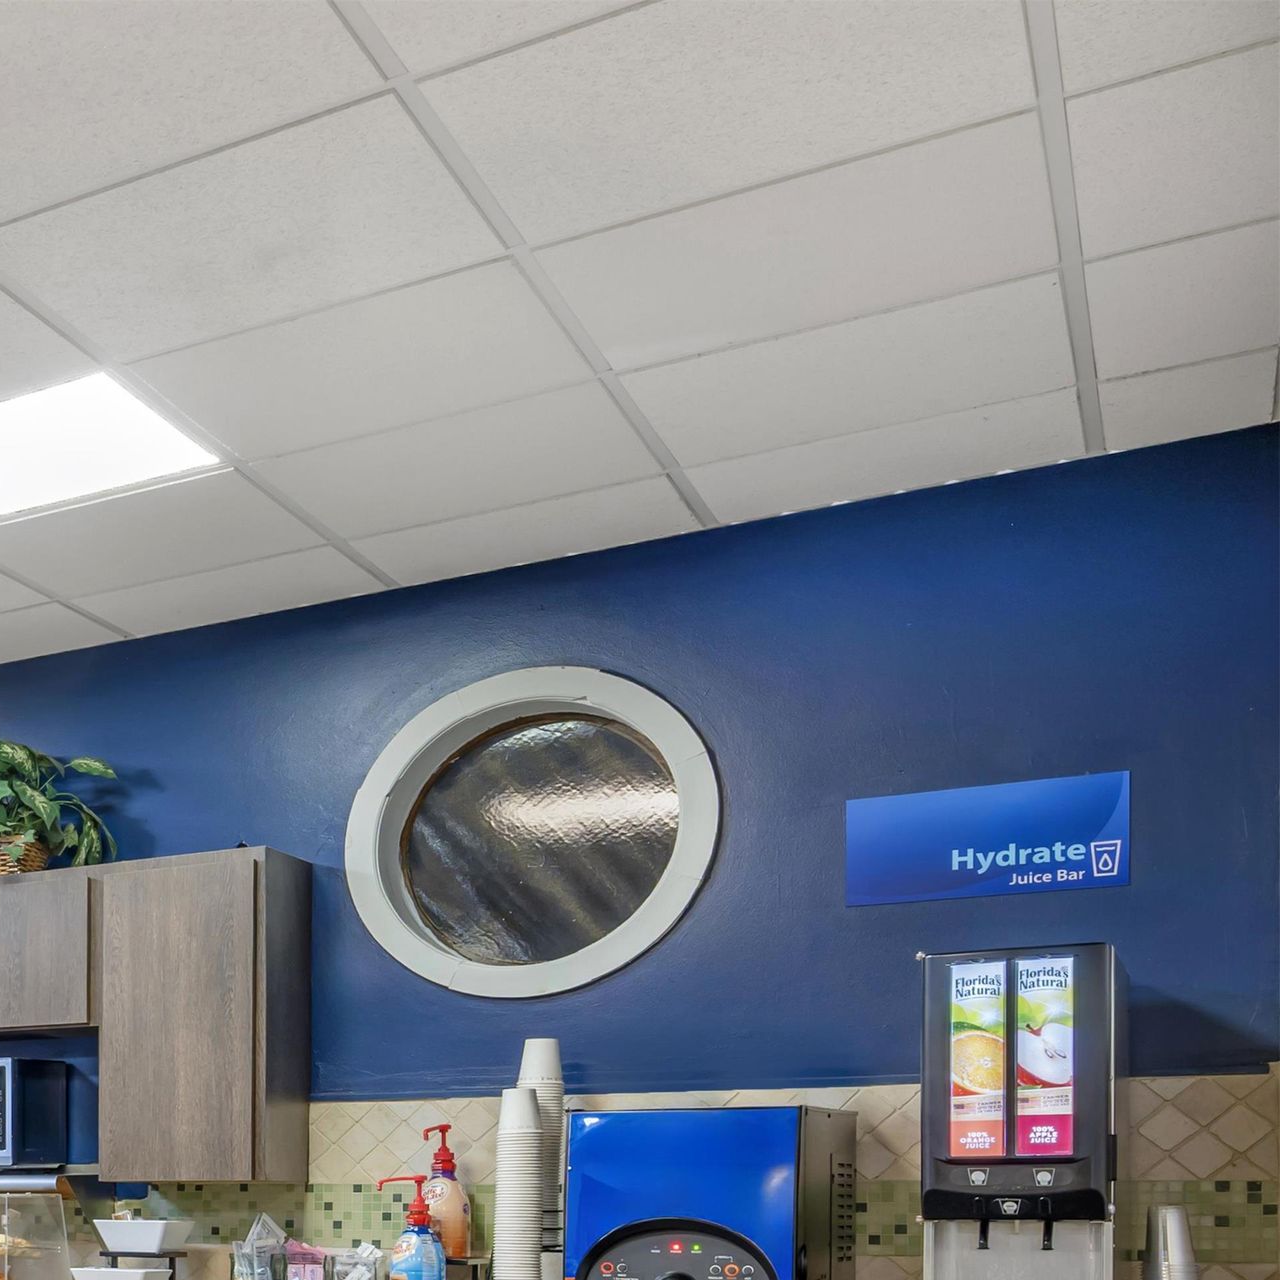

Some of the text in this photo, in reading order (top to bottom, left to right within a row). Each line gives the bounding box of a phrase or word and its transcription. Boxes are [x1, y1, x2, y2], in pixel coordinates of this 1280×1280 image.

[951, 841, 1086, 875] Hydrate
[1008, 869, 1086, 886] Juice Bar
[1020, 978, 1067, 991] Natural
[955, 986, 1001, 999] Natural
